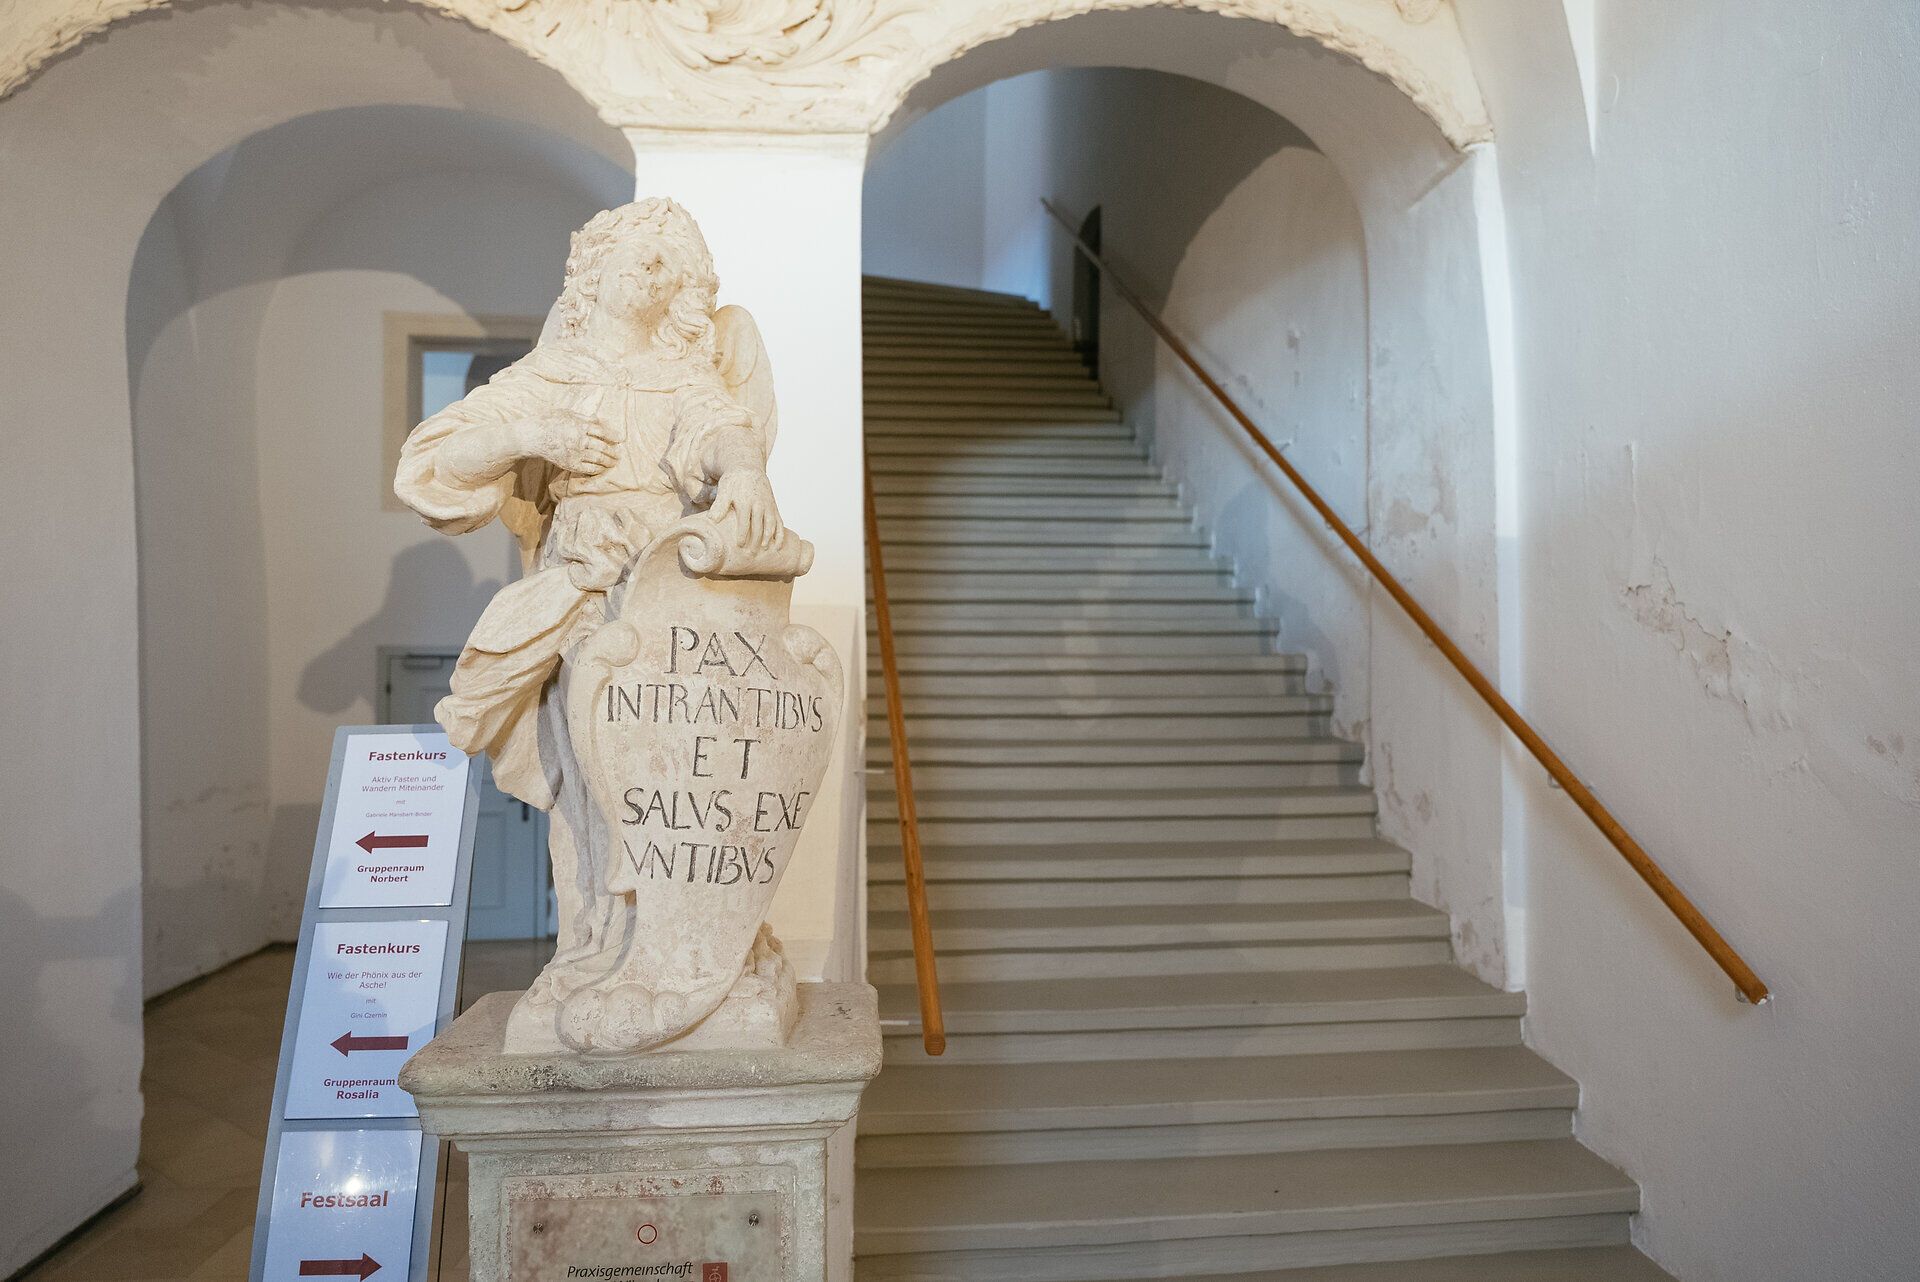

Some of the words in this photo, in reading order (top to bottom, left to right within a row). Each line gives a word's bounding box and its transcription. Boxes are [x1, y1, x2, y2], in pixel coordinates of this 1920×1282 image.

[664, 626, 778, 680] PAX
[607, 683, 823, 733] INTRANTIBVS
[368, 751, 447, 761] Fastenkurs
[692, 736, 761, 780] ET
[372, 776, 392, 784] Aktiv
[399, 784, 444, 792] Miteinander
[622, 787, 732, 833] SALVS
[754, 791, 811, 833] EXE
[623, 840, 775, 885] VNTIBVS
[357, 865, 425, 873] Gruppenraum
[370, 875, 408, 883] Norbert
[337, 943, 421, 954] Fastenkurs
[327, 972, 343, 980] Wie
[345, 971, 359, 979] der
[361, 971, 389, 979] Phönix
[359, 981, 387, 989] Asche!
[324, 1078, 396, 1088] Gruppenraum
[336, 1090, 379, 1099] Rosalia
[300, 1191, 389, 1208] Festsaal
[567, 1261, 694, 1280] Praxisgemeinschaft
